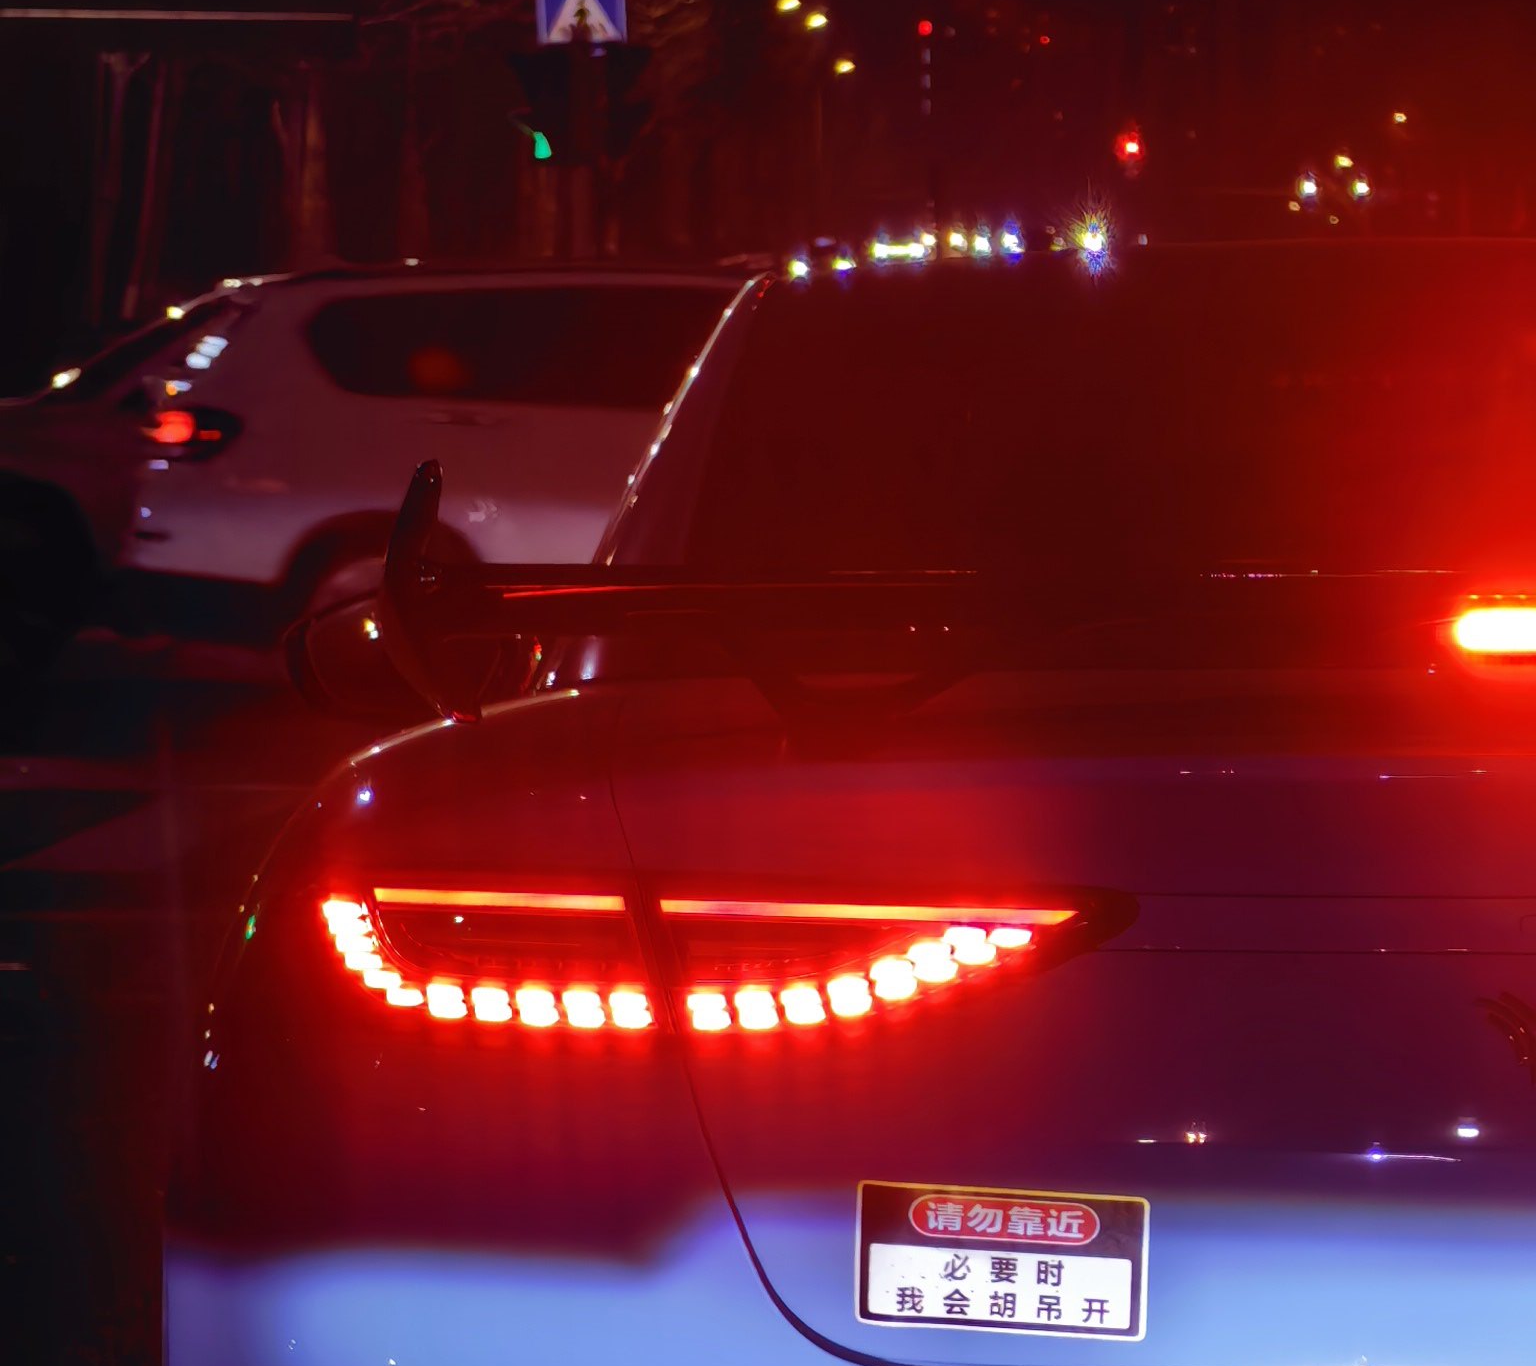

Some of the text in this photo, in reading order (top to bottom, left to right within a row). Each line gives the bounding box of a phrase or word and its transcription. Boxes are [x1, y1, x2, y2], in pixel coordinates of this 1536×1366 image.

[926, 1201, 1085, 1239] 请勿靠近
[943, 1253, 1065, 1287] 必要时
[896, 1287, 1110, 1325] 我会胡吊开
